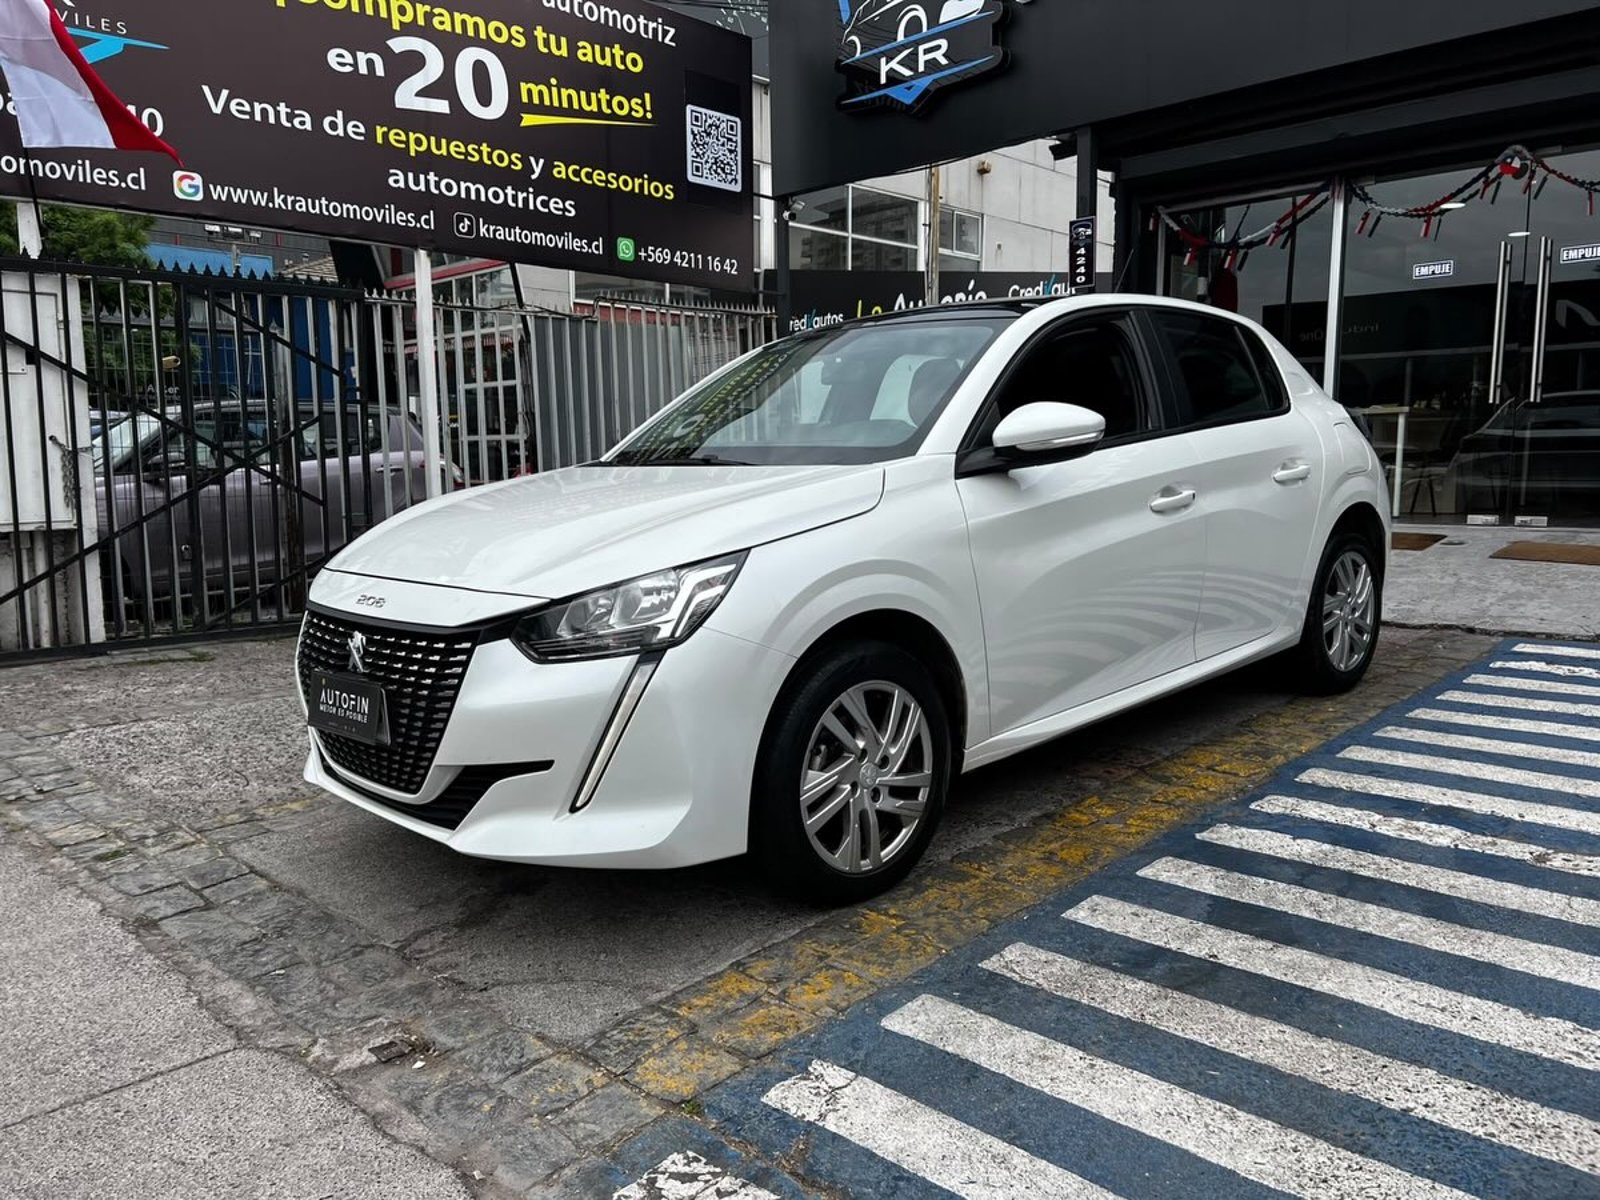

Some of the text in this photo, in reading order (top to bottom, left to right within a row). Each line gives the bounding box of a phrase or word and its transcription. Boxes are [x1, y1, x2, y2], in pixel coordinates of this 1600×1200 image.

[534, 25, 569, 58] tu
[576, 40, 644, 73] auto
[879, 38, 949, 85] KR
[326, 36, 653, 120] en 20 minutos!
[201, 84, 675, 201] Venta de repuestos y accesorios
[209, 183, 435, 230] www.krautomoviles.cl
[388, 167, 576, 217] automotrices
[478, 217, 603, 255] krautomoviles.cl
[638, 246, 738, 275] +569 4211 16 42
[1075, 247, 1087, 284] 4240
[1415, 263, 1451, 276] EMPUJE
[320, 688, 369, 714] AUTOFIN
